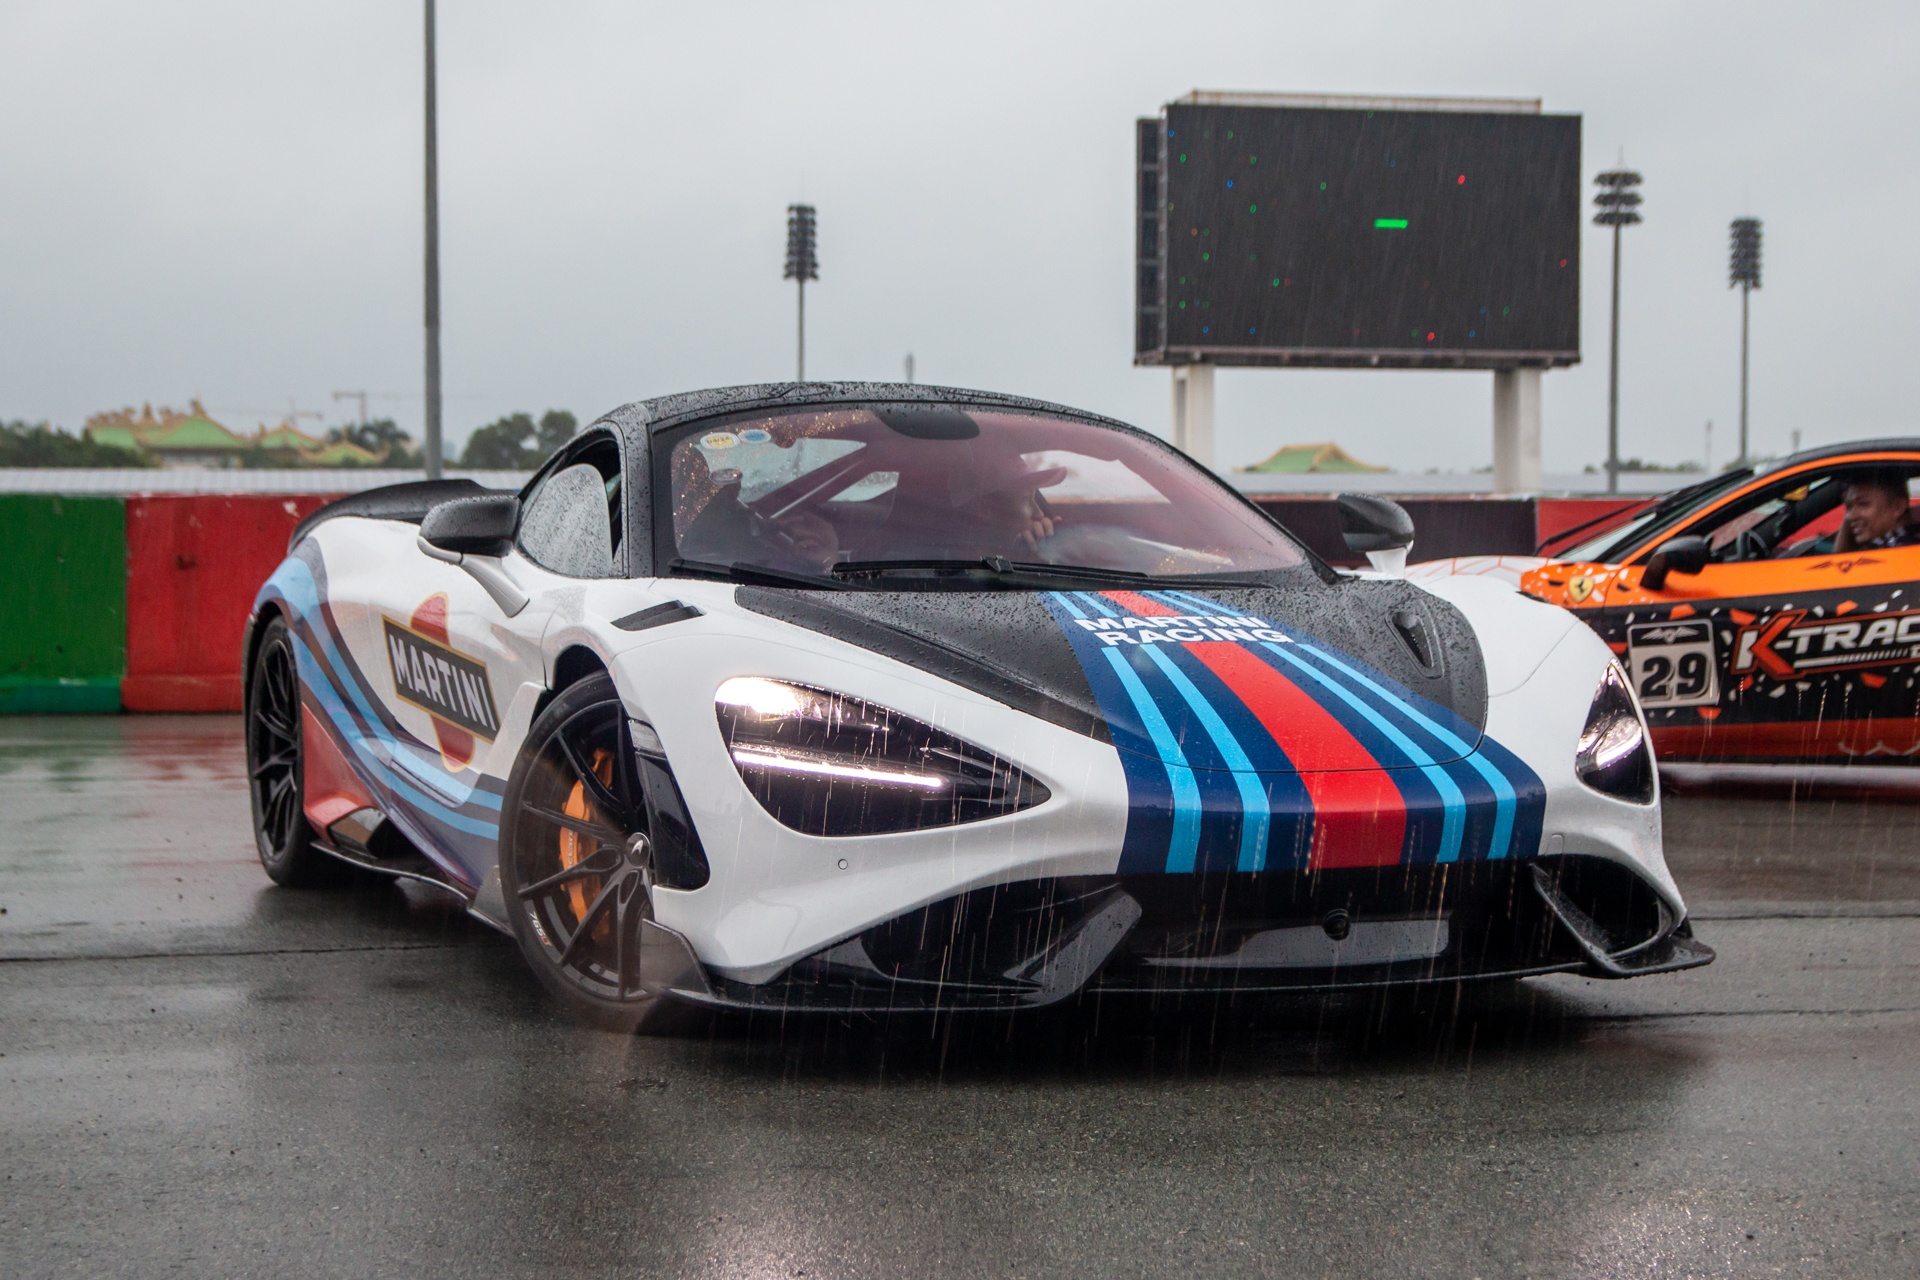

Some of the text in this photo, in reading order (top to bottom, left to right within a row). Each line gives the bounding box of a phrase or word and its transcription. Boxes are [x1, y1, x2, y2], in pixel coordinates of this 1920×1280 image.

[1074, 616, 1271, 631] MARTINI
[1094, 628, 1294, 646] RACING
[389, 633, 496, 732] MARTINI
[1640, 652, 1709, 698] 29
[529, 911, 552, 946] 765LT
